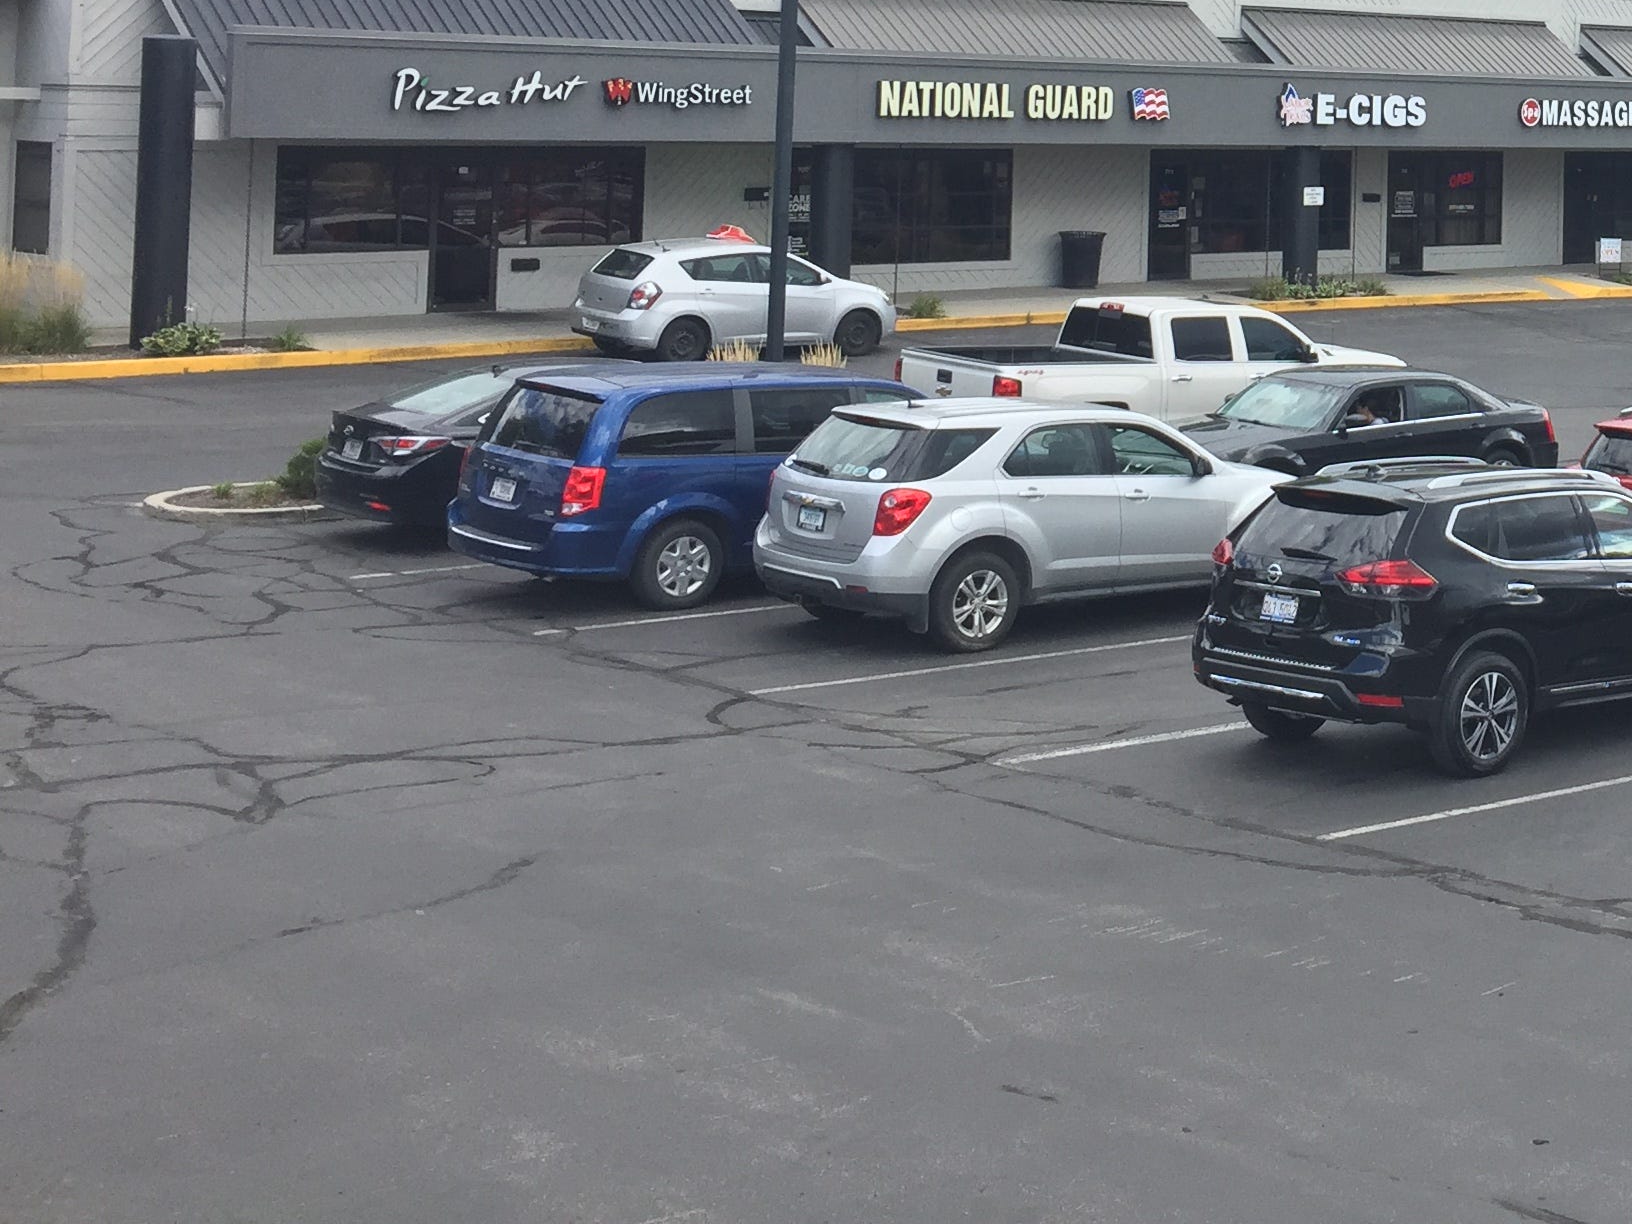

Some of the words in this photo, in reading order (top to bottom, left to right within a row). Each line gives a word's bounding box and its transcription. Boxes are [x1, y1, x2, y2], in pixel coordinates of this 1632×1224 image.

[393, 67, 501, 111] Pizza
[510, 70, 588, 105] Hut
[636, 80, 752, 109] WingStreet
[878, 80, 1014, 118] NATIONAL
[1027, 84, 1114, 120] GUARD
[1316, 92, 1427, 126] E-CIGS
[1523, 104, 1539, 120] Spa
